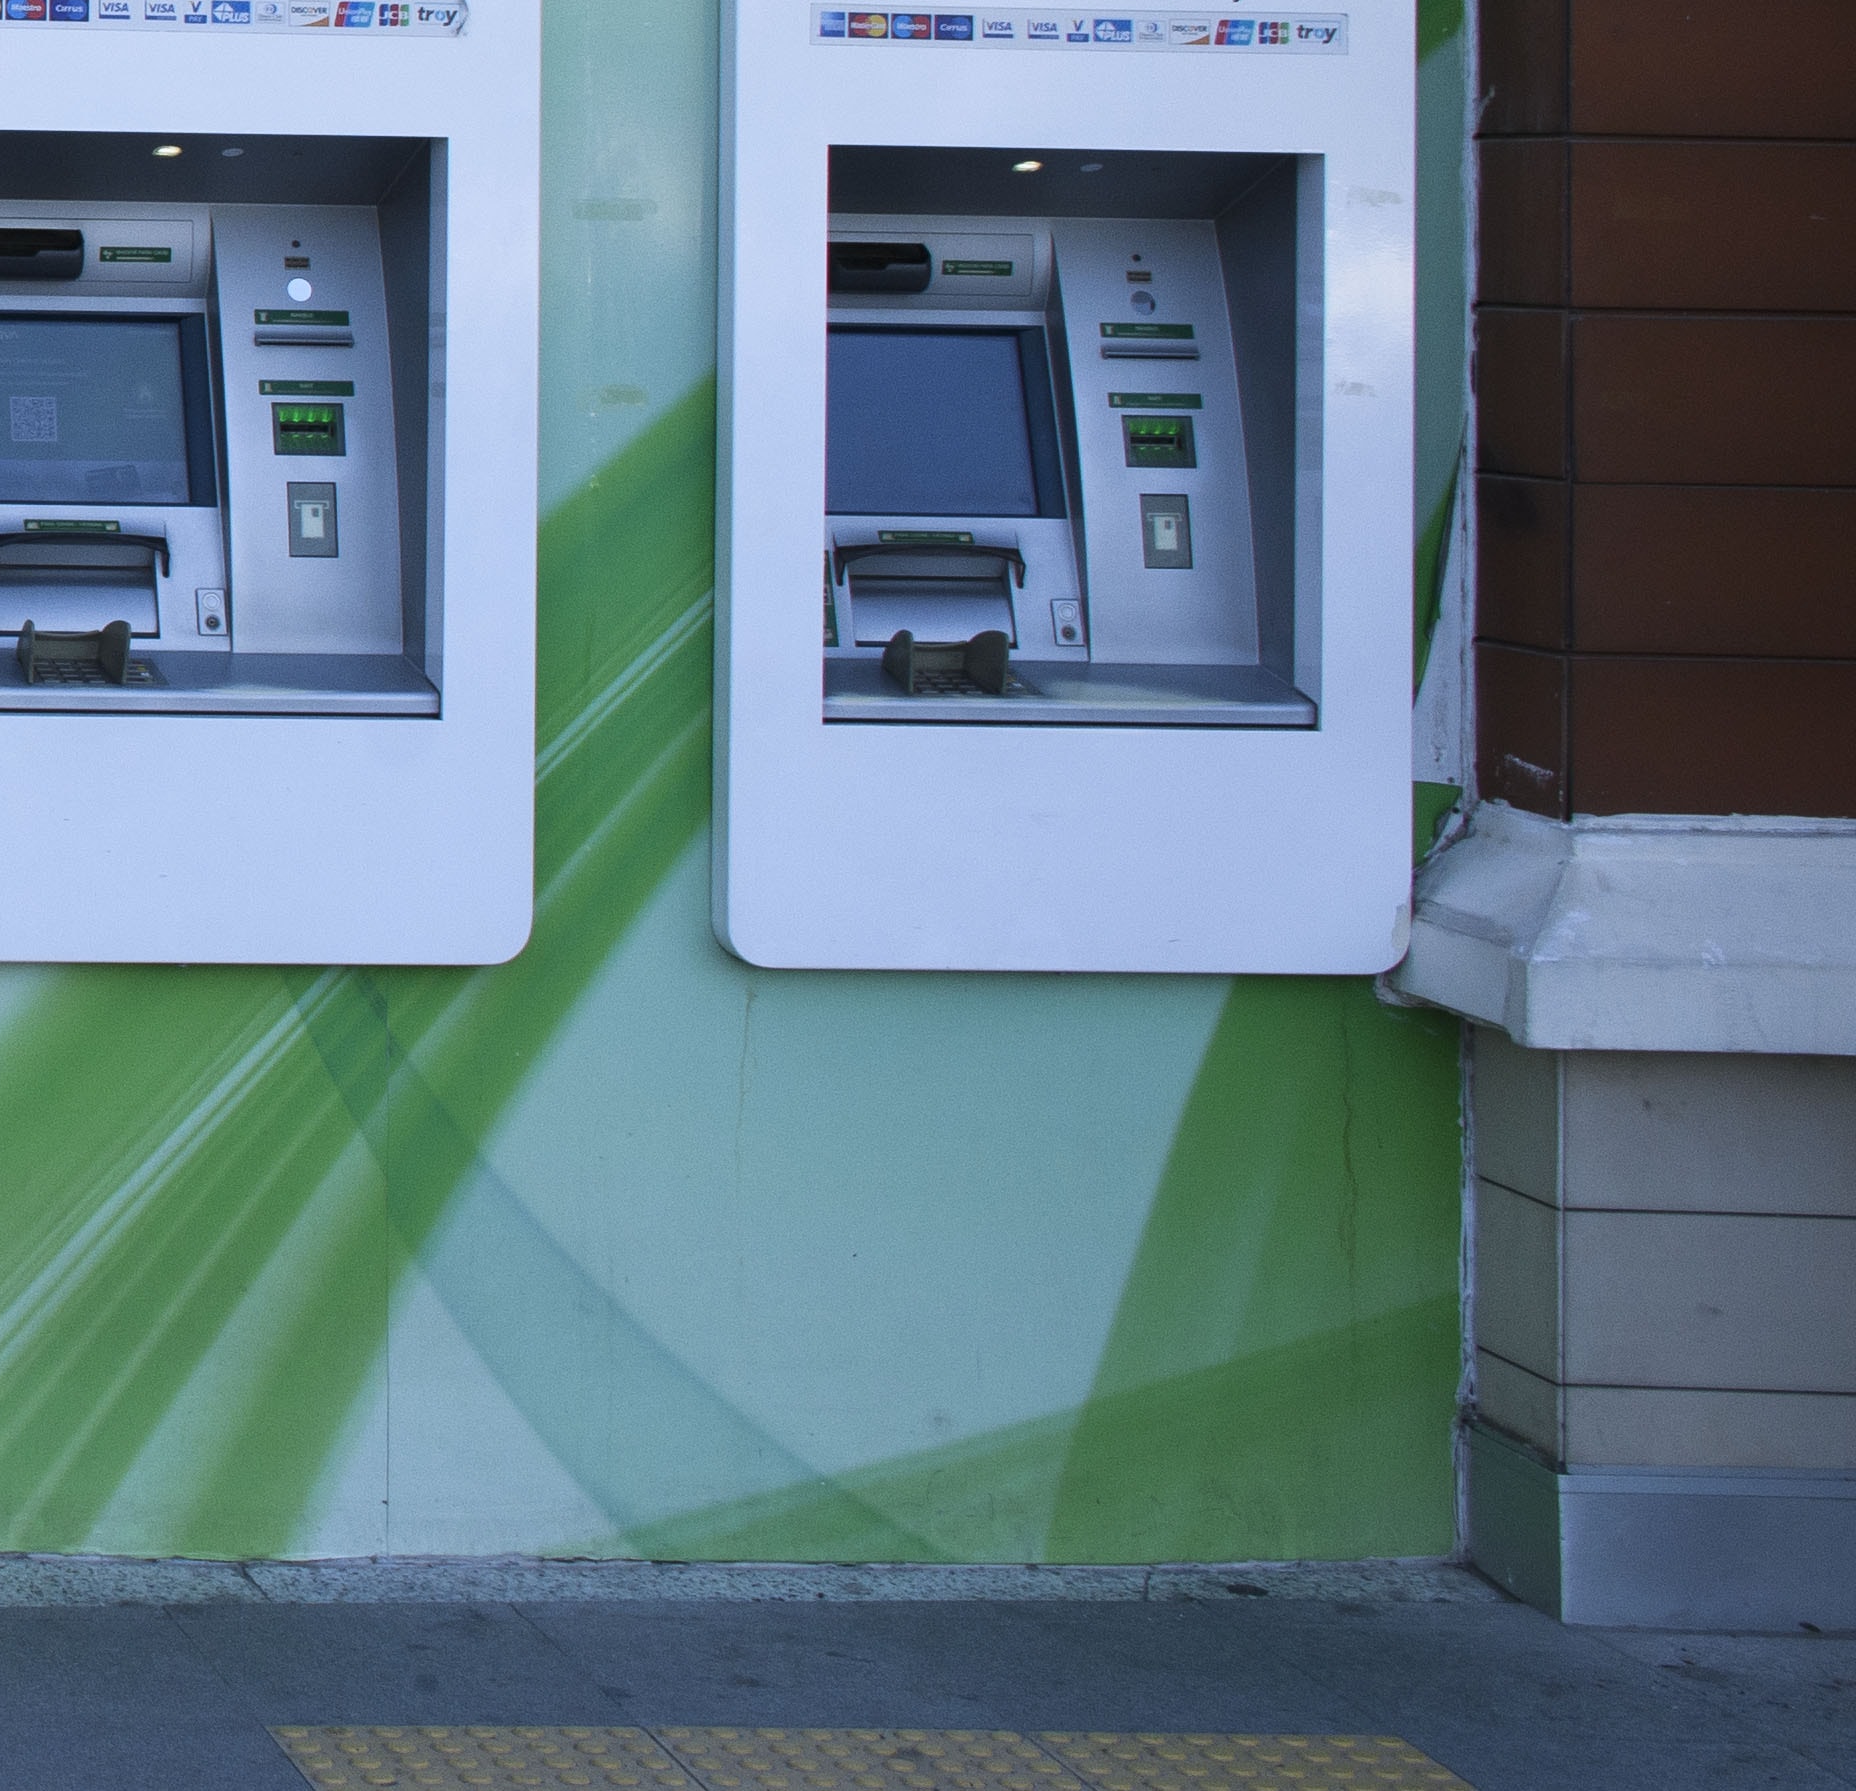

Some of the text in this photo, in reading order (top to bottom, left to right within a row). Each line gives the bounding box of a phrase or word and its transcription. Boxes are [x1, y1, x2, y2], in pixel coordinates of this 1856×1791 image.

[55, 3, 84, 14] Cirrus
[102, 2, 129, 13] VISA
[148, 3, 176, 14] VISA
[291, 6, 328, 15] DISCOVER
[223, 11, 250, 23] PLUS
[380, 9, 410, 20] JCB
[417, 6, 458, 26] troy
[940, 23, 969, 33] Cirrus
[987, 21, 1013, 32] VISA
[1031, 22, 1058, 33] VISA
[1171, 24, 1208, 33] DISCOVER
[1105, 30, 1132, 42] PLUS
[1259, 28, 1290, 38] JCB
[1296, 23, 1338, 44] troy
